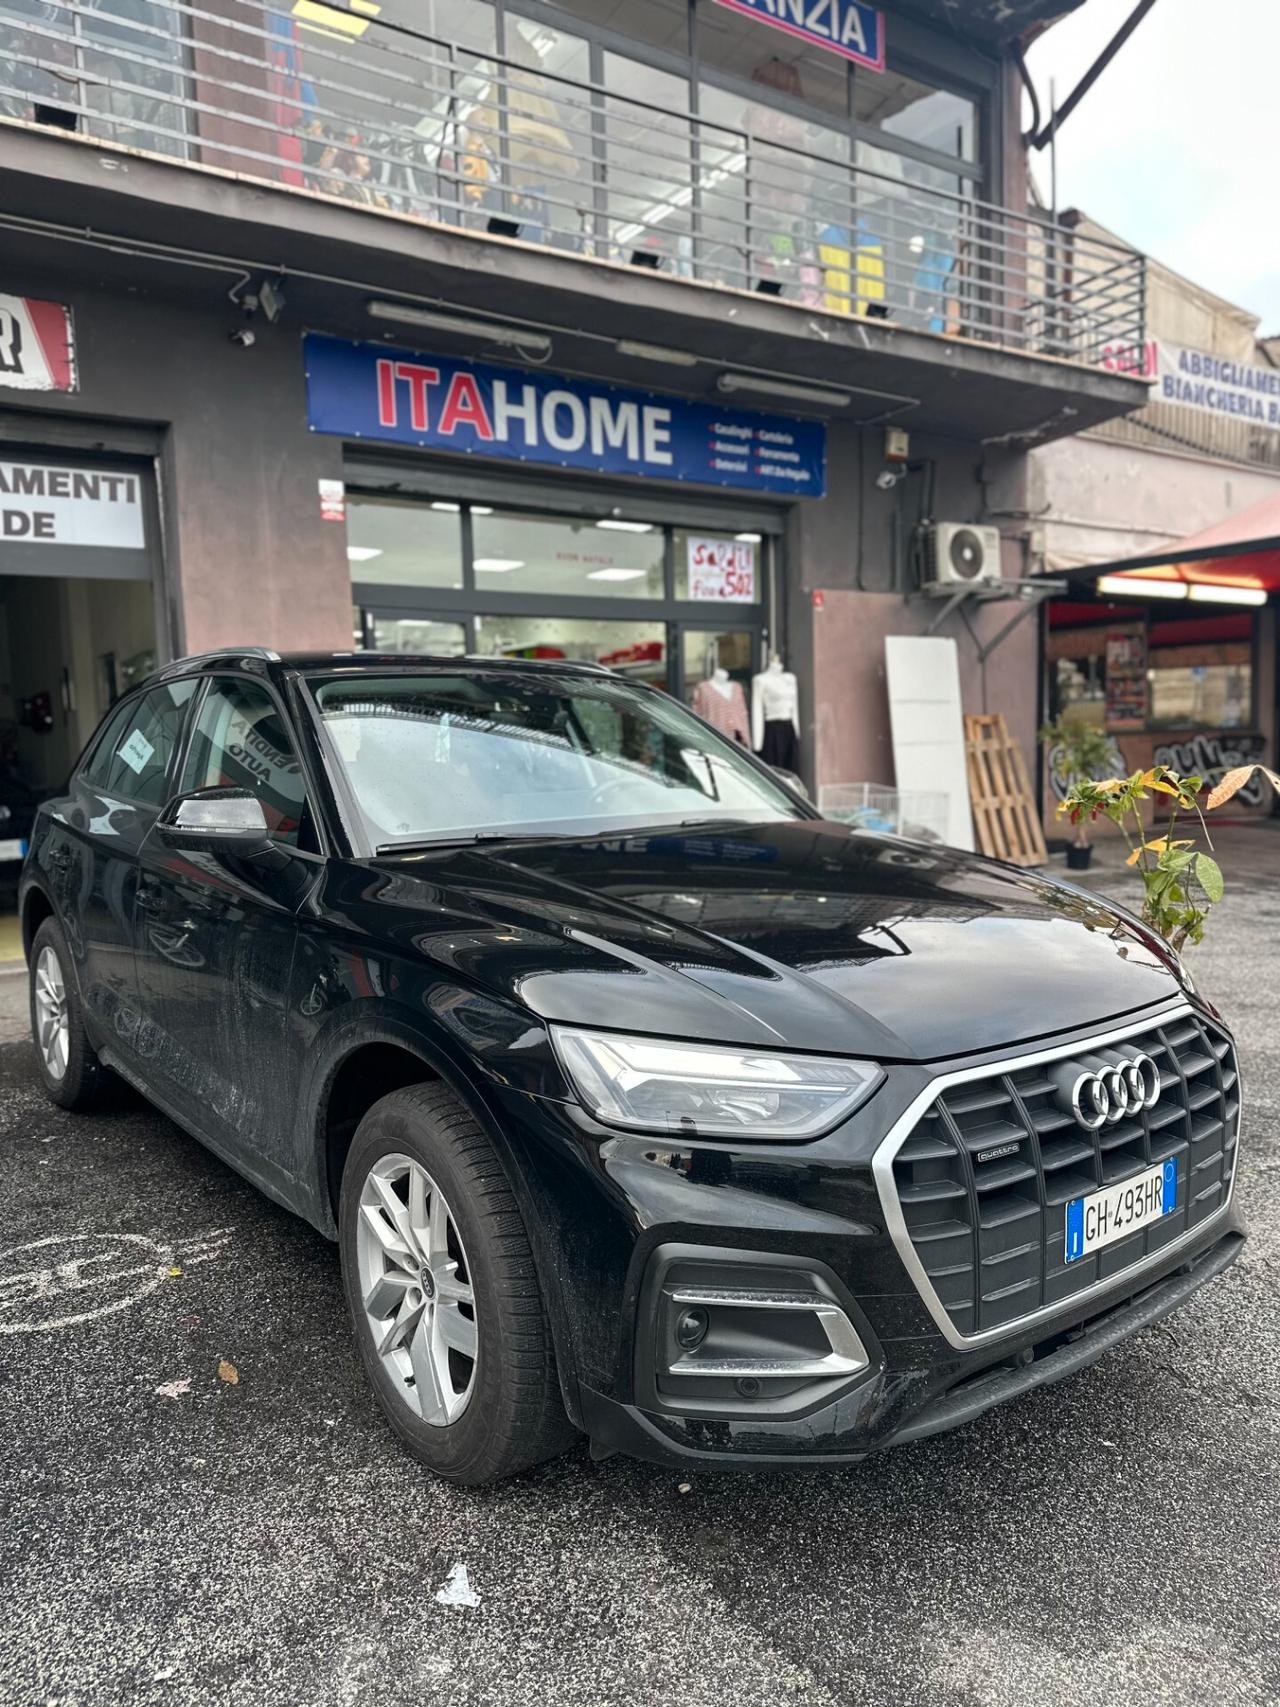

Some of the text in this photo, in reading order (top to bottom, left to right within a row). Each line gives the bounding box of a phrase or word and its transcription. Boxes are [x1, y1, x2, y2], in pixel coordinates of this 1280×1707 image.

[1178, 350, 1280, 396] ABBIGLIAME
[376, 358, 673, 466] ITAHOME
[1163, 374, 1280, 424] BIANCHERIA B
[0, 466, 136, 504] MENTI
[980, 1145, 1019, 1160] quattro
